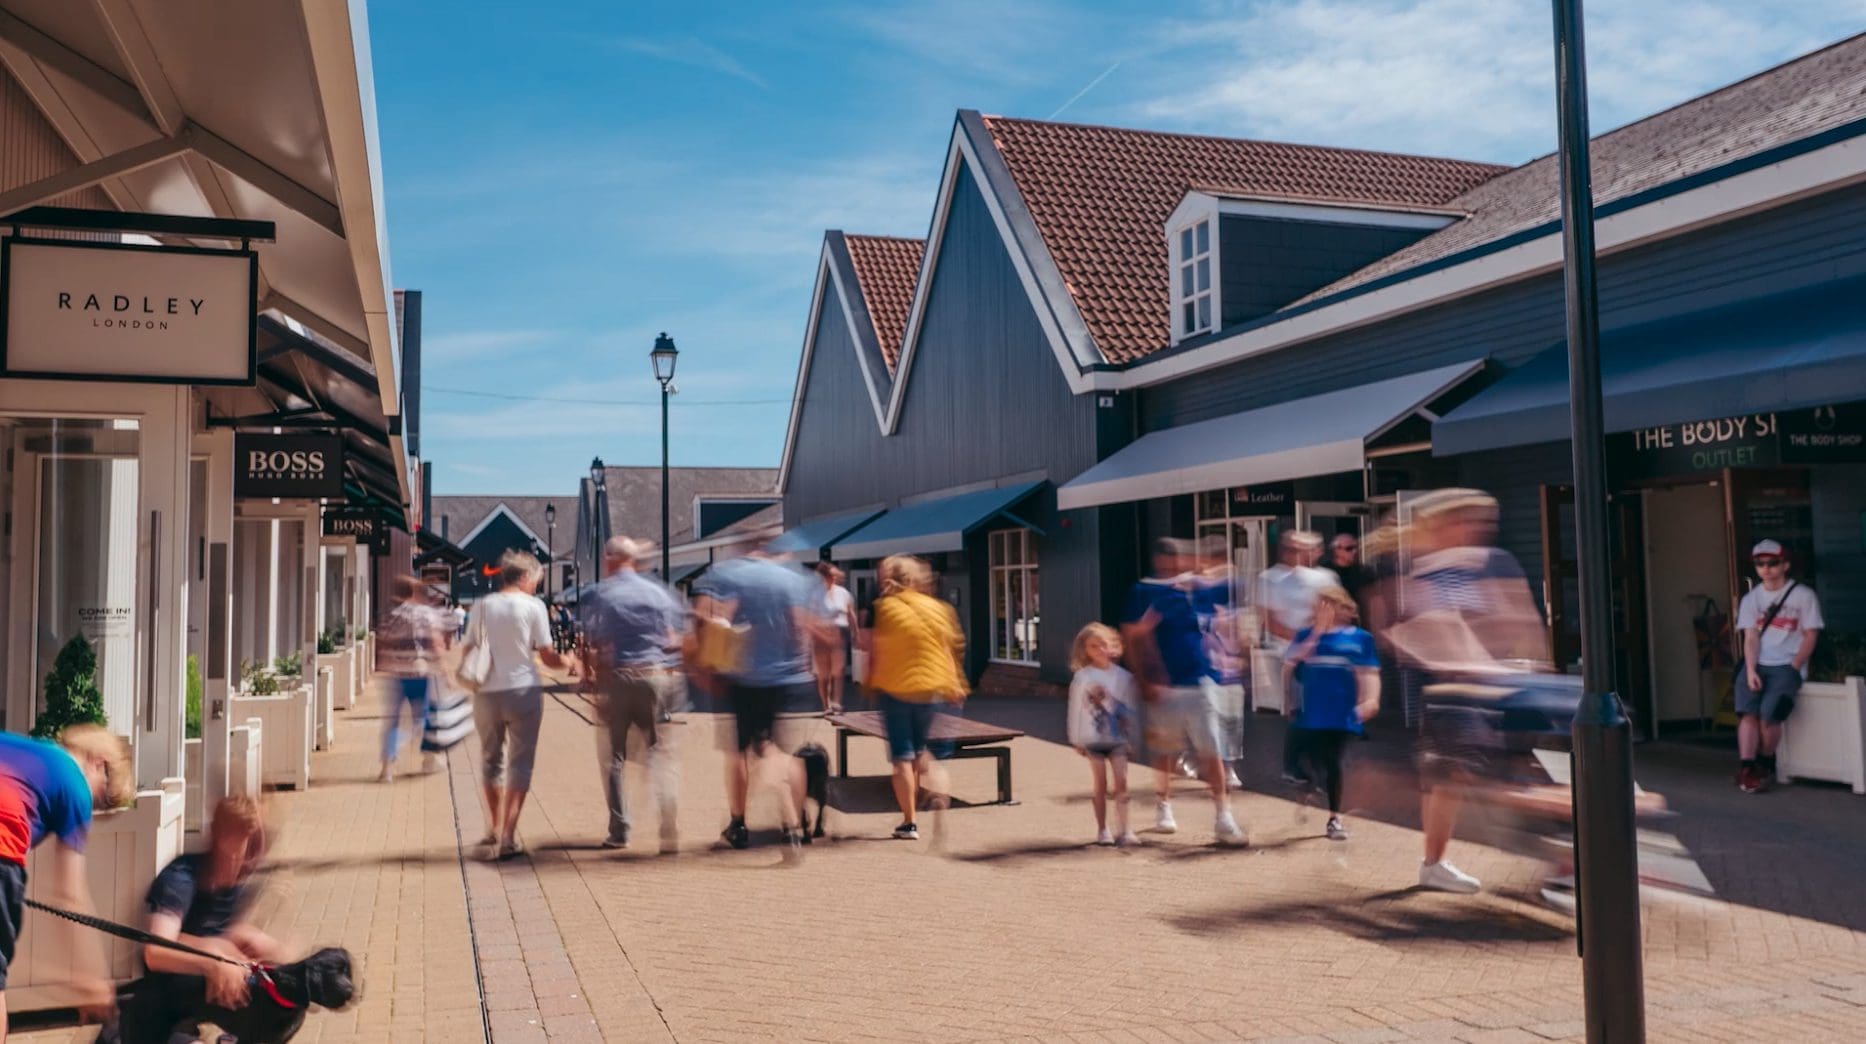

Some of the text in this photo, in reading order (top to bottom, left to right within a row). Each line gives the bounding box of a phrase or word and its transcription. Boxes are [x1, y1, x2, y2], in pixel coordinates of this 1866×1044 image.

[58, 292, 204, 315] RADLEY
[93, 318, 168, 330] LONDON
[1633, 426, 1674, 451] THE
[1682, 416, 1748, 446] BODY
[1790, 434, 1862, 446] THE BODY SHOP
[249, 451, 324, 472] BOSS
[1692, 446, 1756, 470] OUTLET
[1251, 492, 1284, 503] Leather
[333, 519, 373, 531] BOSS
[116, 607, 131, 615] IN!
